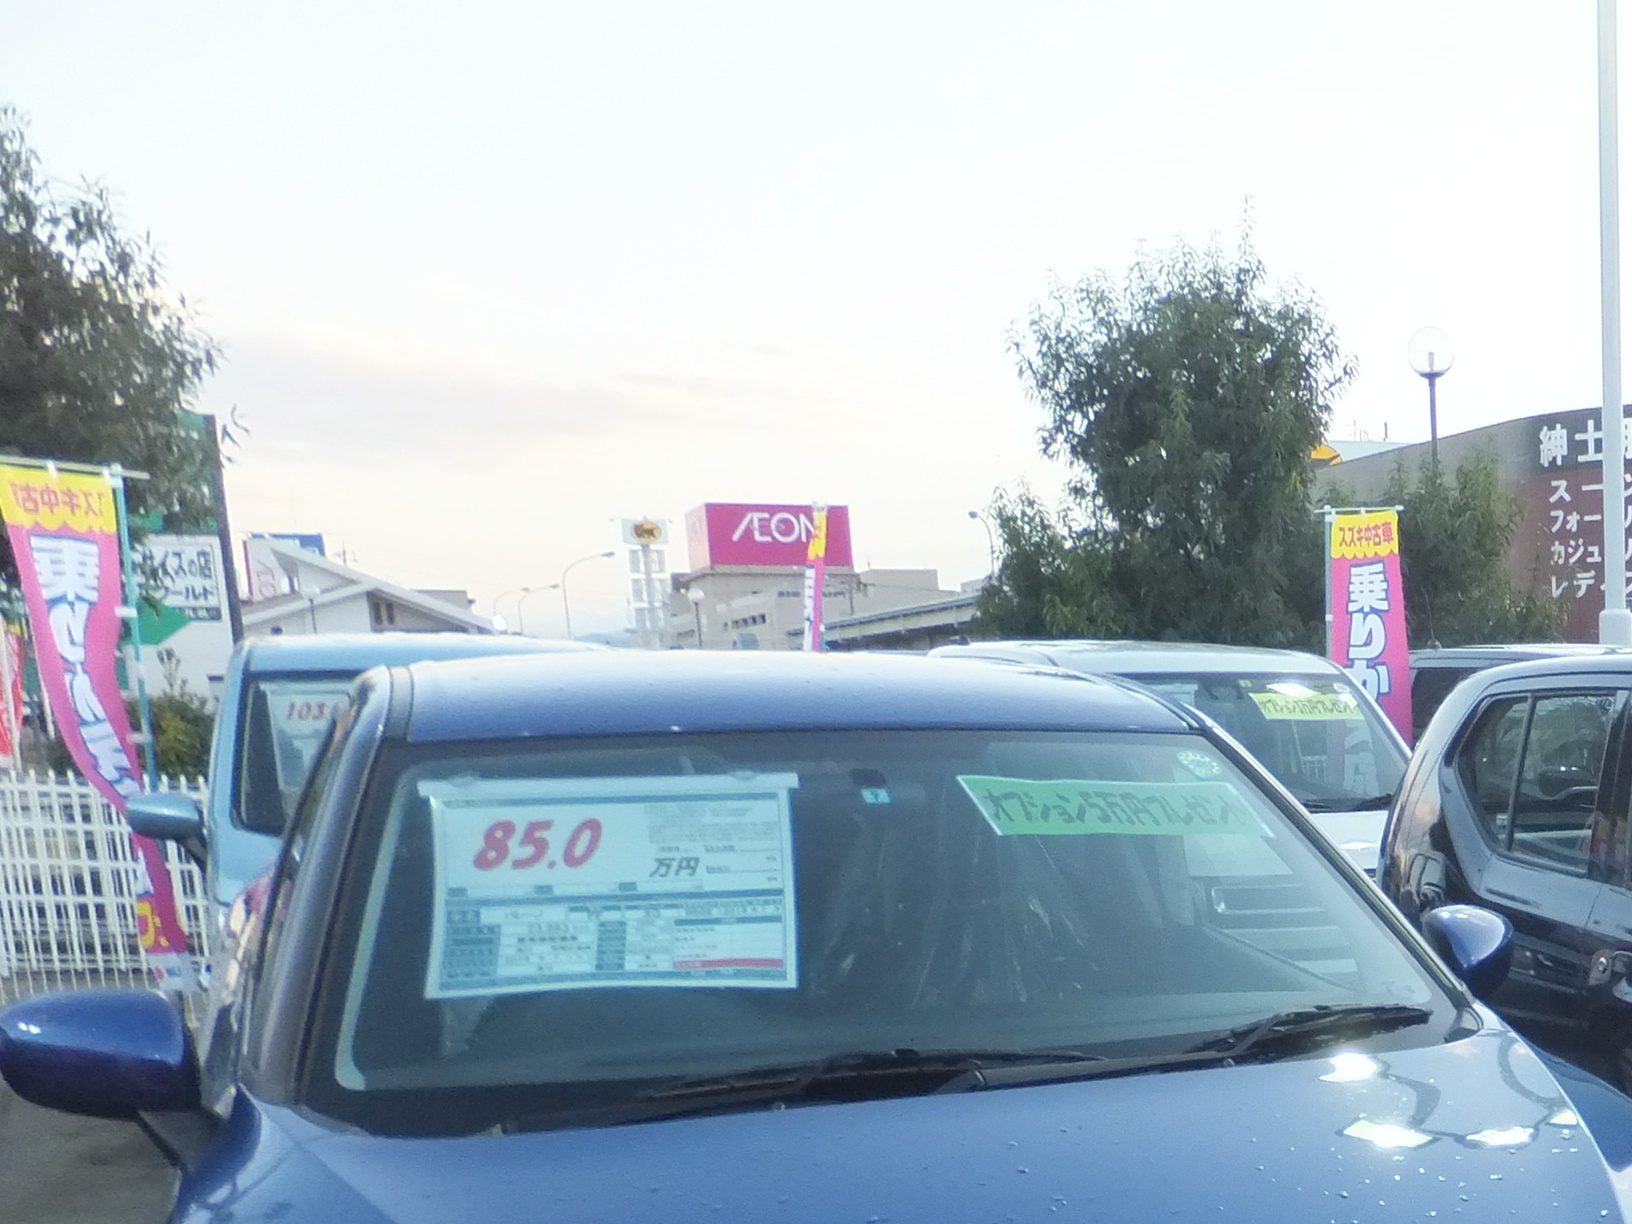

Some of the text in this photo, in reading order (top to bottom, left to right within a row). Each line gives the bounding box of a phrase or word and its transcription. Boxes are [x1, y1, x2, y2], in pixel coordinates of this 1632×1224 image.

[1338, 521, 1395, 548] スズキ中古車
[473, 817, 603, 872] 85.0
[648, 855, 701, 878] 万円
